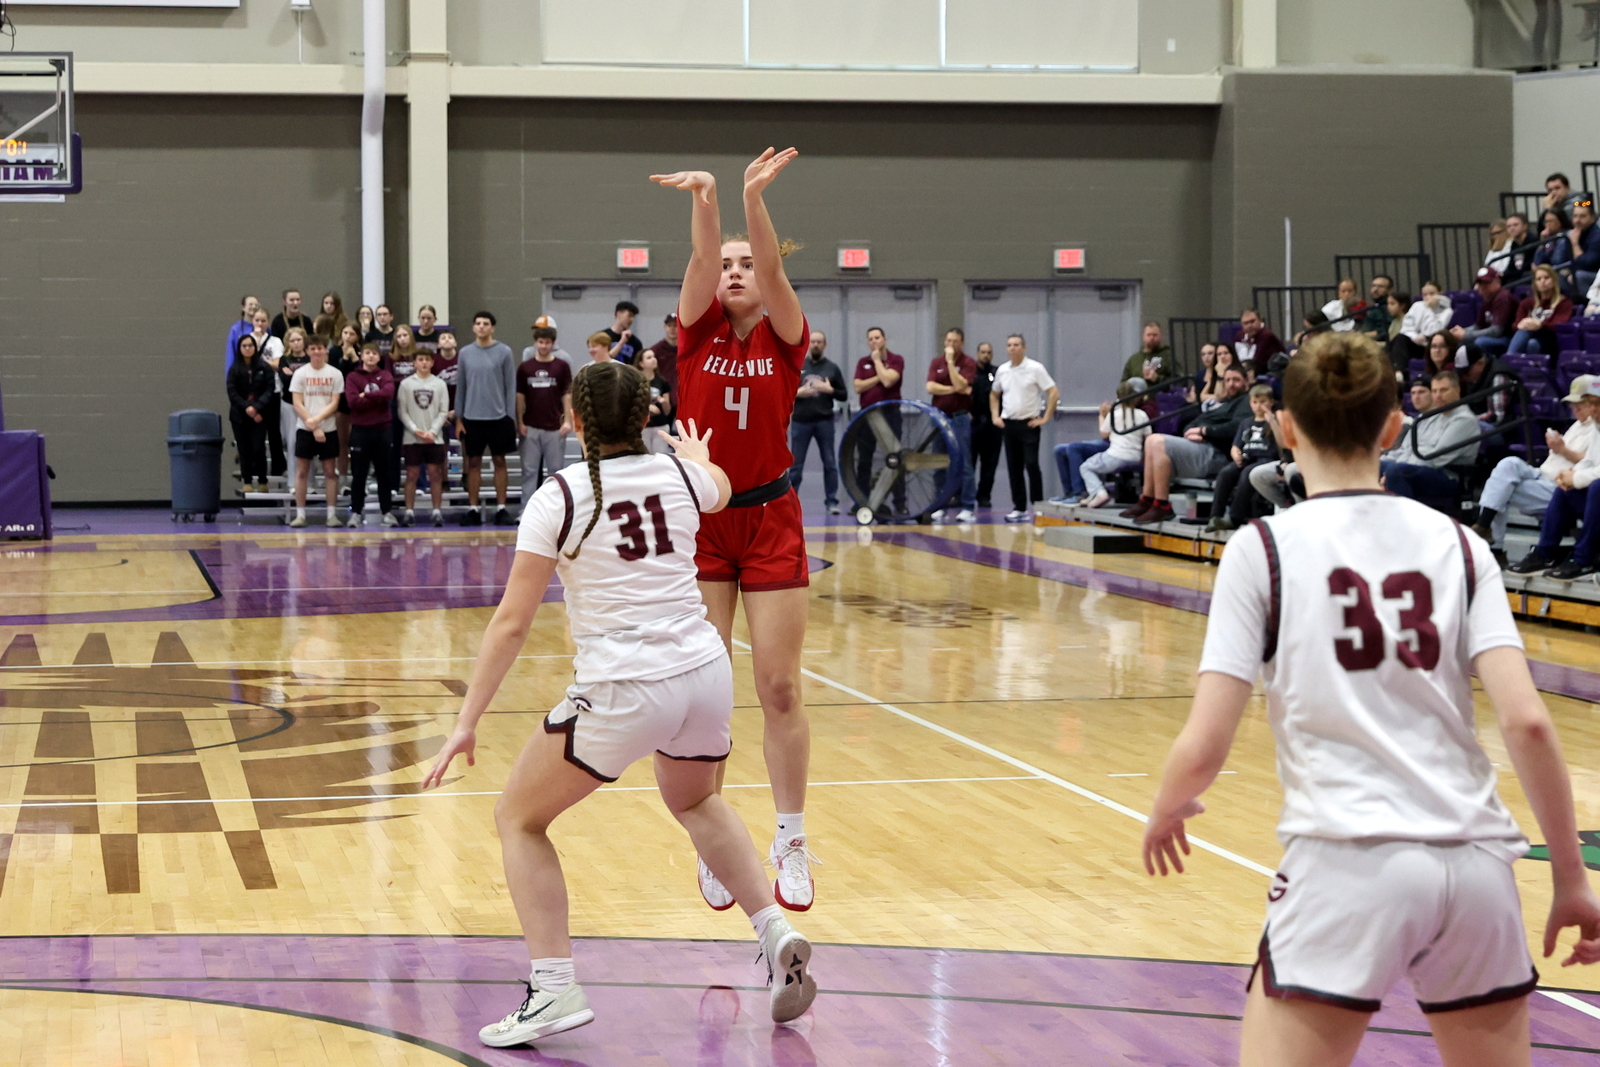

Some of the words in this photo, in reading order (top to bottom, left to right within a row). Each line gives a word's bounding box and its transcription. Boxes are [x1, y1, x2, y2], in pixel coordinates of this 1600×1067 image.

[702, 354, 775, 378] BELLEVUE
[724, 386, 750, 430] 4
[607, 493, 675, 562] 31
[1328, 567, 1441, 672] 33
